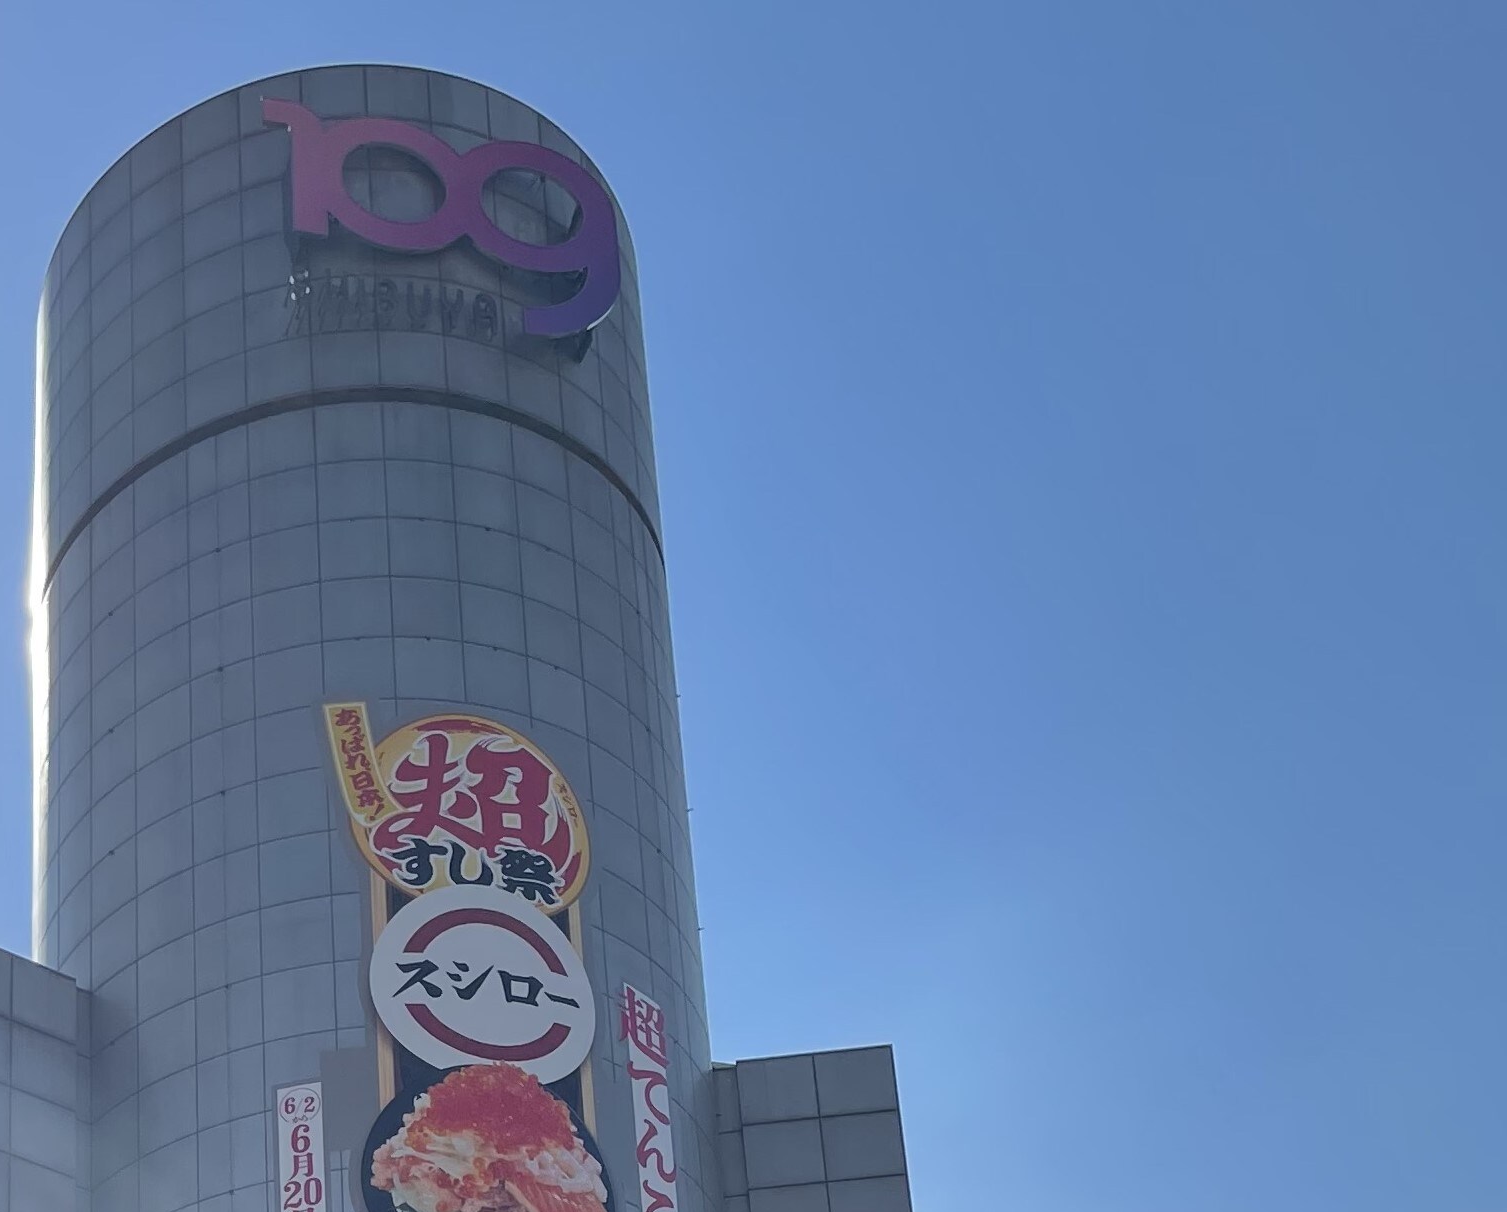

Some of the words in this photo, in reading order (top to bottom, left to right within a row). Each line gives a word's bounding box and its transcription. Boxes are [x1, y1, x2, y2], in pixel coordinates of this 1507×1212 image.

[261, 96, 621, 337] 109
[392, 959, 581, 1009] スシロー
